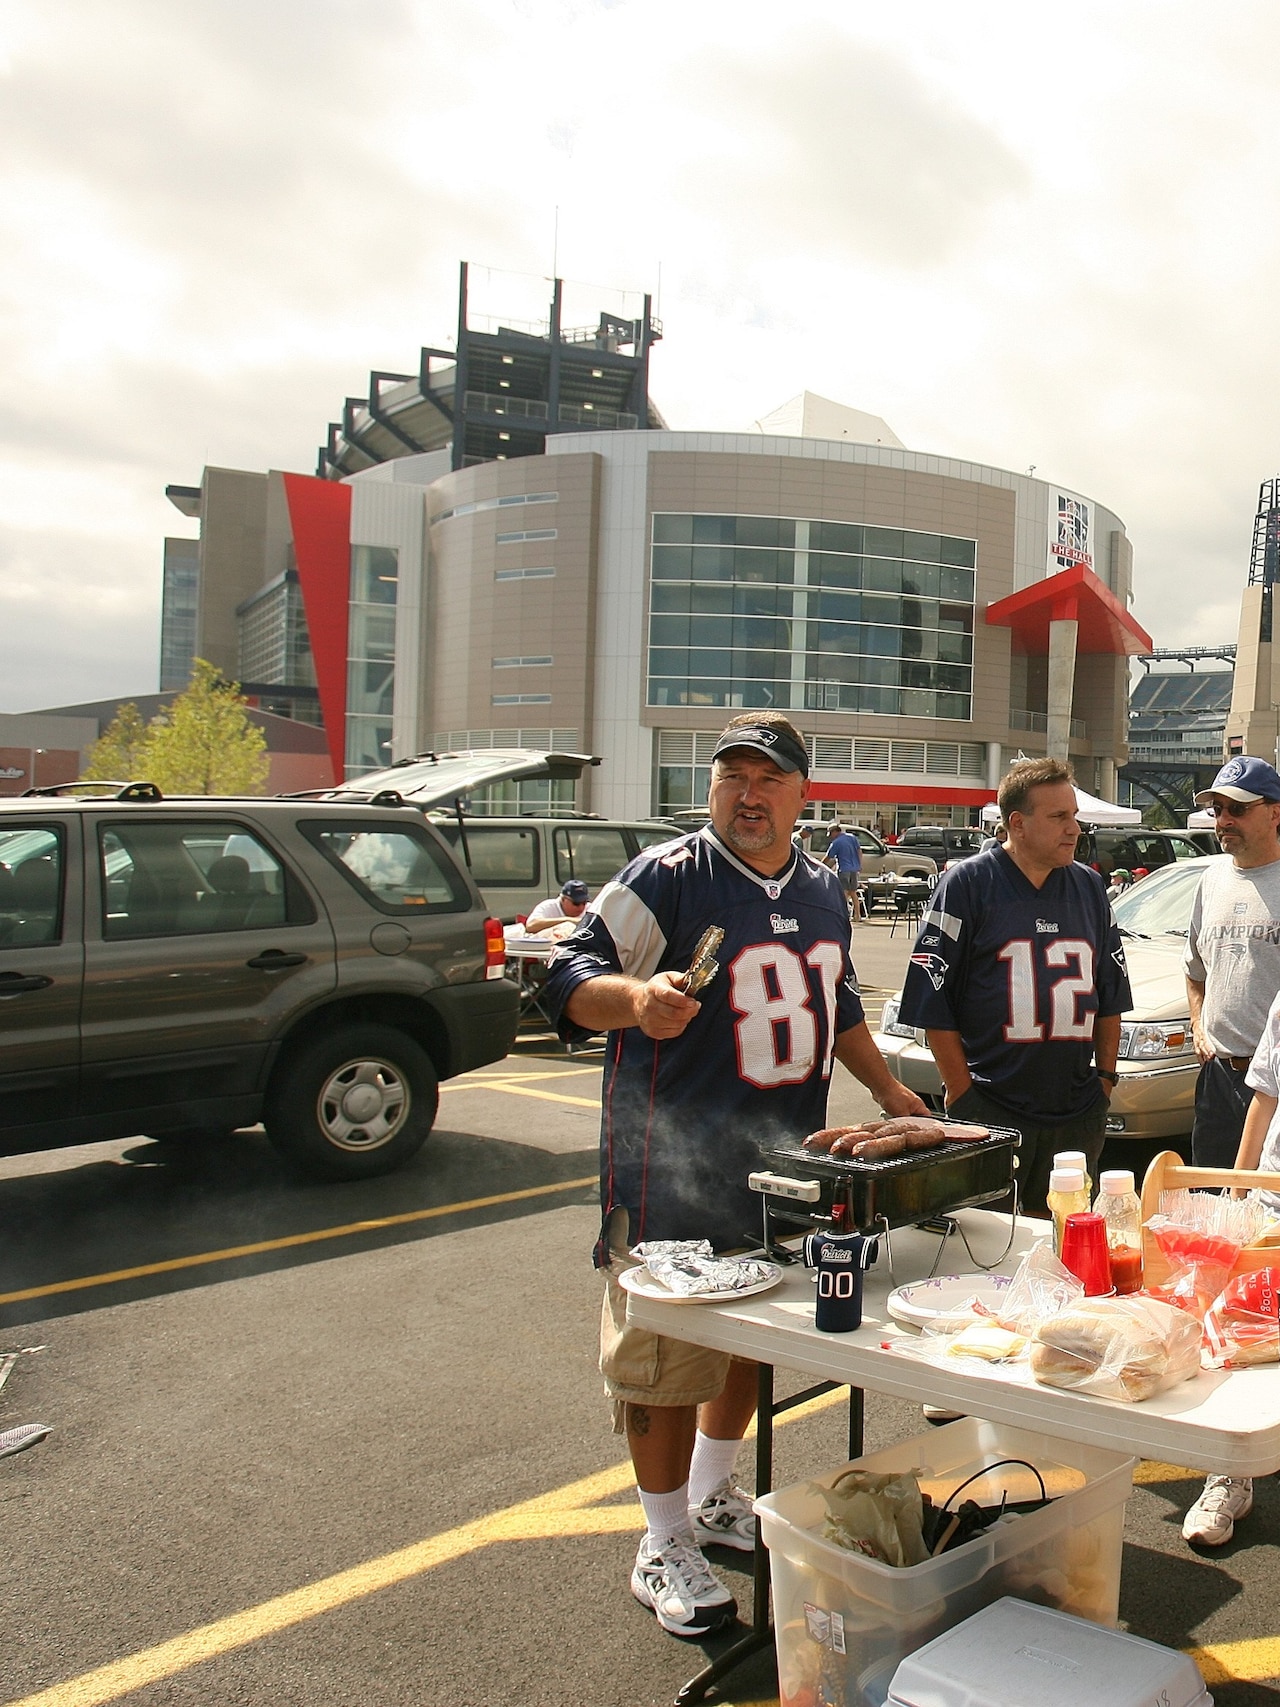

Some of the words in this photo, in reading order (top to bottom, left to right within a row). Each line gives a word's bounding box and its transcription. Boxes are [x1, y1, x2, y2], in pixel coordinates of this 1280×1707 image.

[1052, 544, 1070, 557] THE
[1072, 551, 1092, 565] HALL
[730, 940, 844, 1090] 81
[996, 937, 1097, 1043] 12
